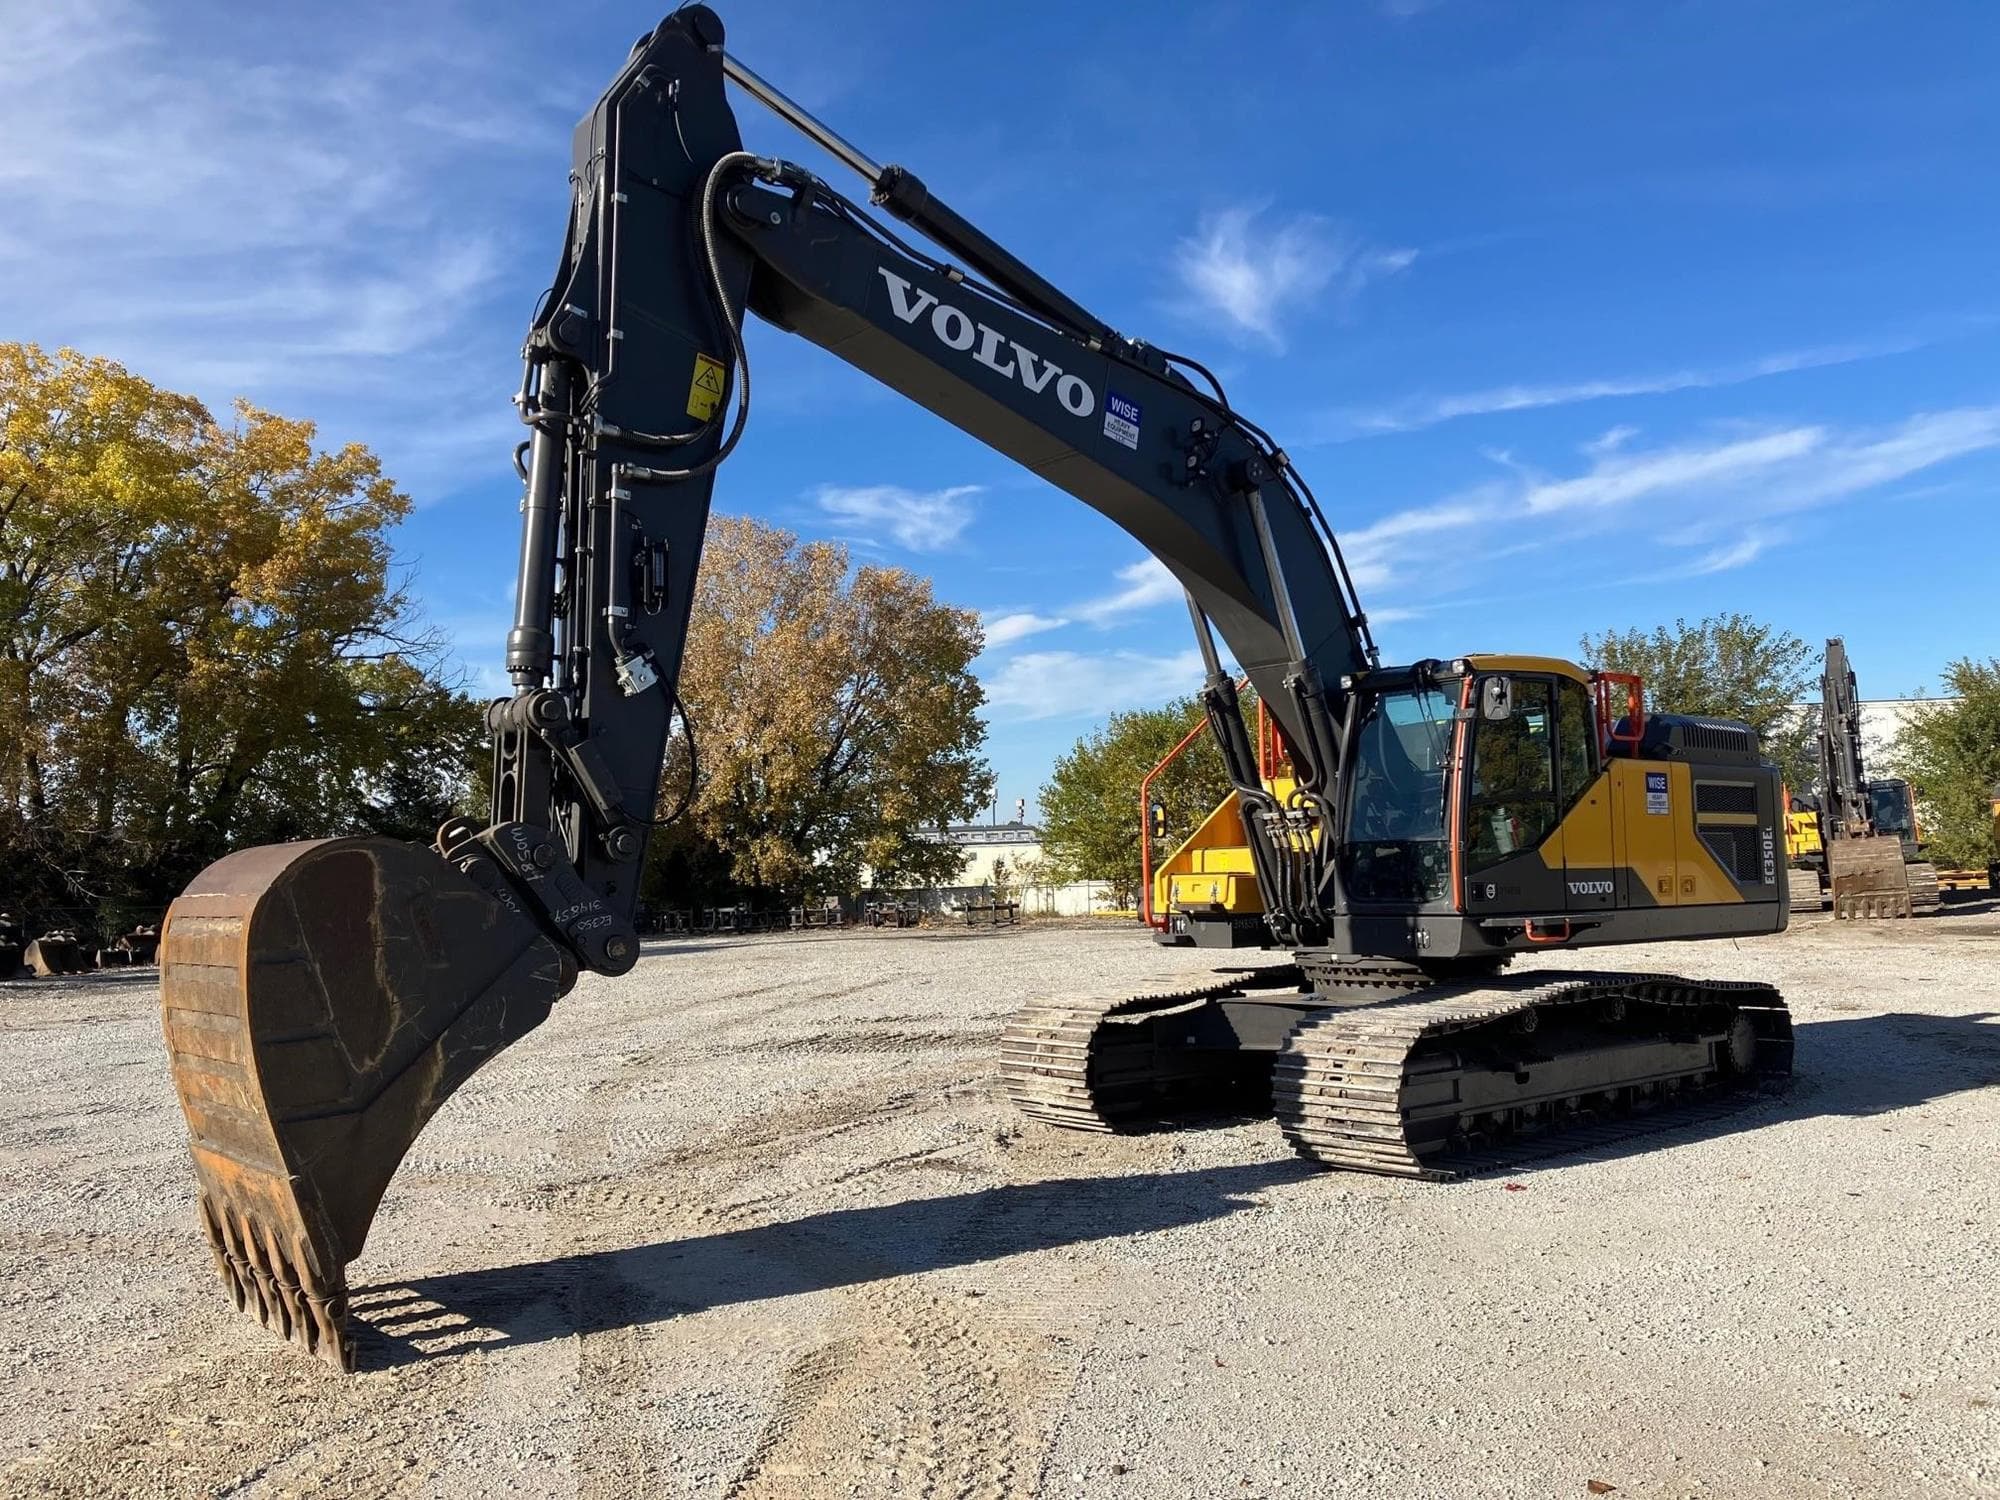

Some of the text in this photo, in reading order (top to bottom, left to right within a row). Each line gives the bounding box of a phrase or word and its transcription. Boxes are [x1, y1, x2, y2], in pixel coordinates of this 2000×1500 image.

[878, 266, 1095, 417] VOLVO
[1111, 396, 1138, 422] WISE
[1648, 776, 1666, 789] WISE
[1568, 881, 1613, 895] VOLVO
